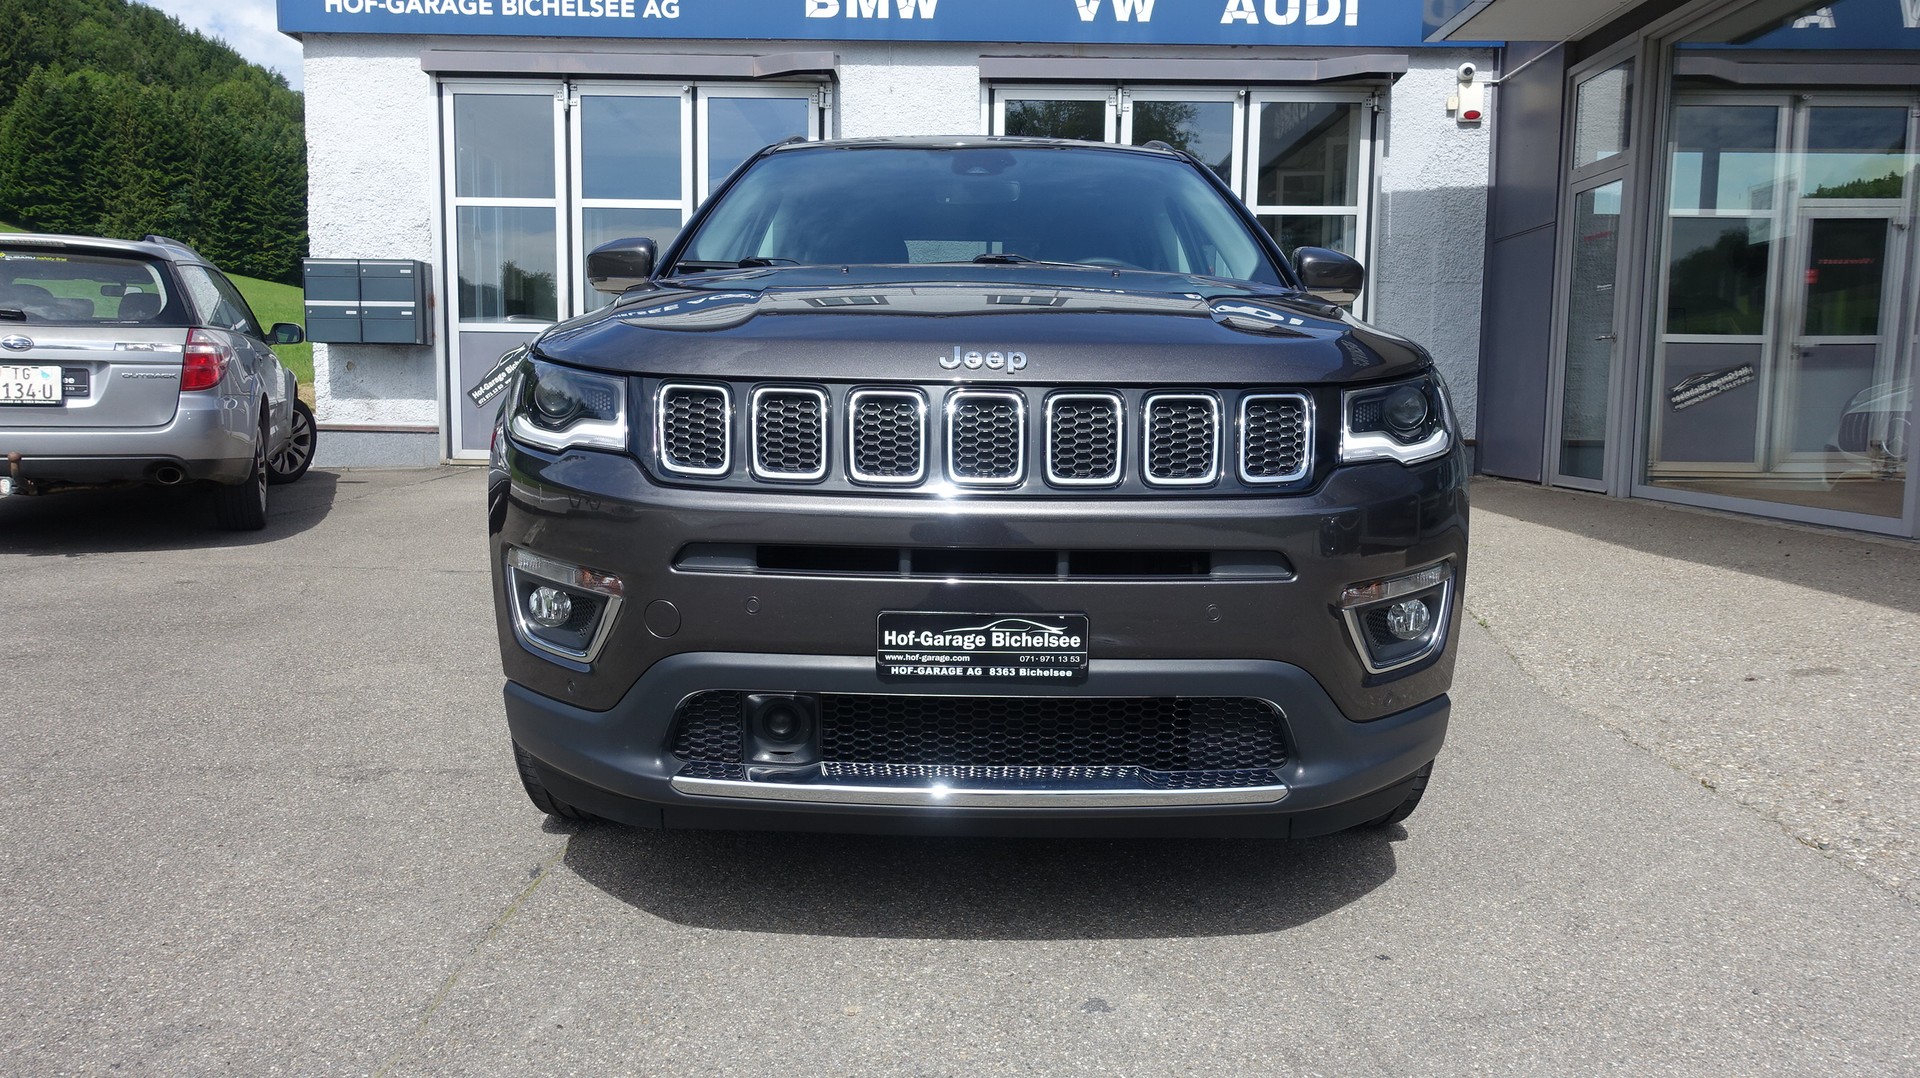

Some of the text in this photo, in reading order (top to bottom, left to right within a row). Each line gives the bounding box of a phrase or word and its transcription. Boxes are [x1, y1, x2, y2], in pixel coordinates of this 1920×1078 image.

[325, 0, 680, 18] HOF-GARAGE BICHELSEE AG
[805, 0, 938, 19] BMW
[1074, 0, 1155, 22] VW
[1220, 0, 1358, 26] AUDI
[939, 346, 1027, 374] Jeep
[12, 367, 31, 380] TG
[884, 630, 1081, 650] Hof-Garage Bichelsee
[885, 653, 970, 663] www.hof-garage.com
[1058, 655, 1068, 663] 13
[891, 666, 1073, 677] HOF-GARAGE AG 8363 Bichelsee
